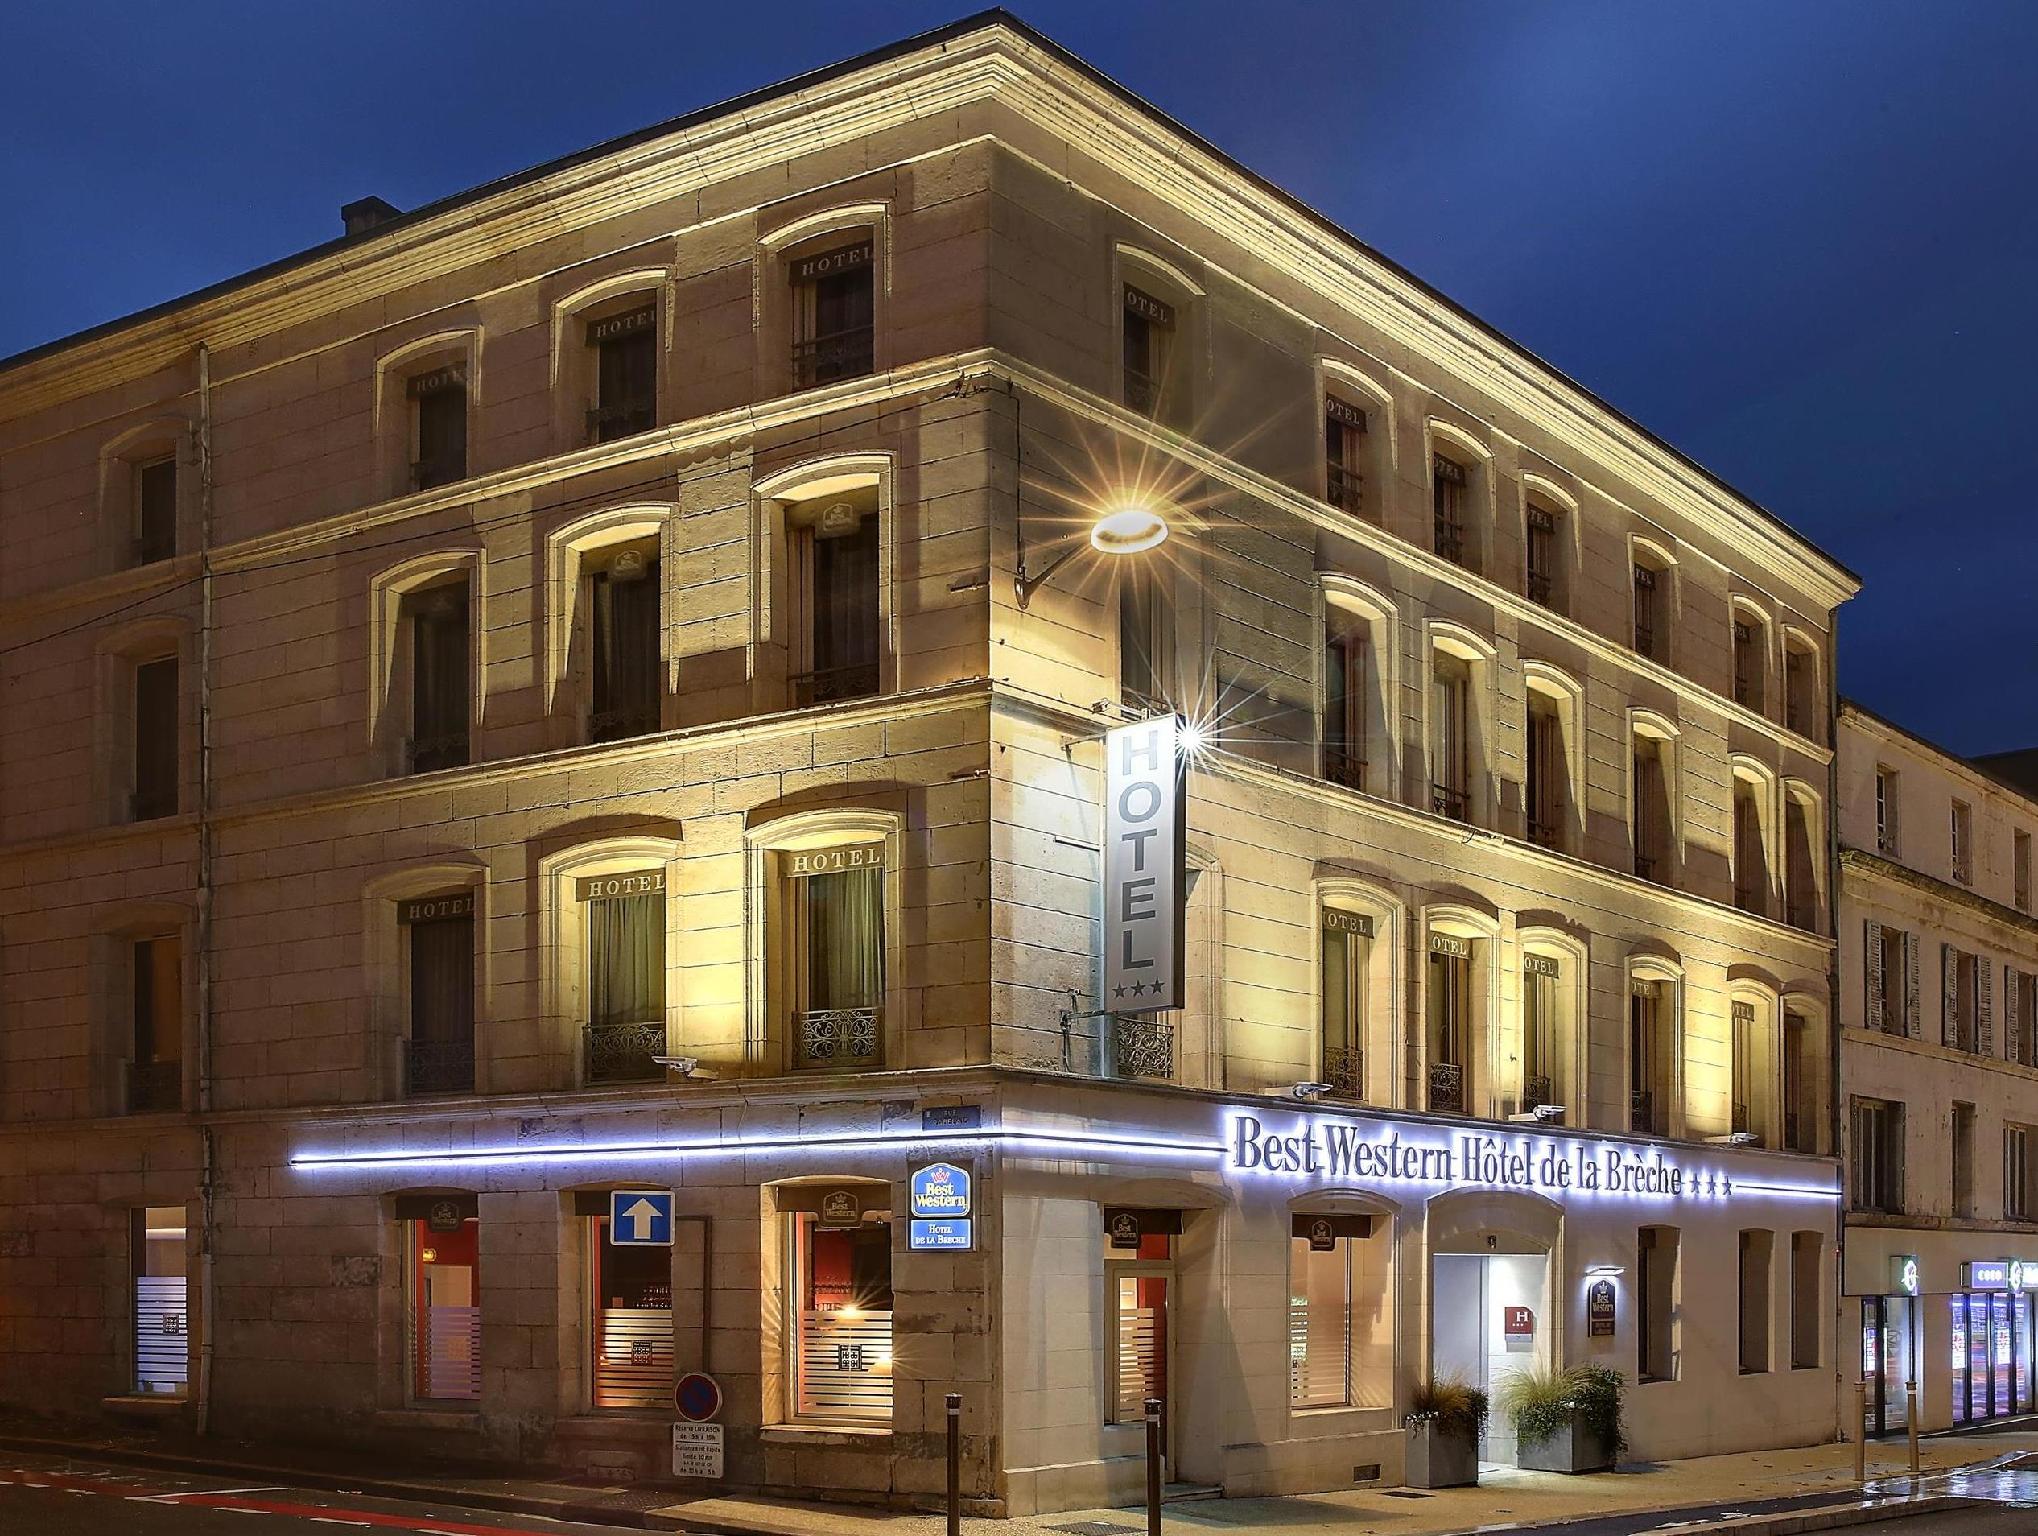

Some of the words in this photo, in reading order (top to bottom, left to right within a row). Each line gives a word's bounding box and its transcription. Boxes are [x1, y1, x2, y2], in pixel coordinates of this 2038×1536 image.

[801, 247, 872, 276] HOTEL
[1127, 291, 1168, 323] OTEL
[1326, 399, 1360, 425] OTEL
[793, 848, 881, 872] HOTEL
[1118, 730, 1162, 970] HOTEL
[588, 874, 666, 897] HOTEL
[409, 898, 472, 919] HOTEL
[1327, 913, 1367, 933] OTEL
[1432, 936, 1468, 955] OTEL
[1524, 956, 1554, 974] OTEL
[1234, 1116, 1317, 1174] Best
[1323, 1124, 1453, 1181] Western
[1461, 1136, 1535, 1185] Hôtel
[1541, 1144, 1571, 1188] de
[1576, 1146, 1600, 1190] la
[1605, 1149, 1683, 1195] Brèche
[925, 1182, 955, 1196] Best
[915, 1194, 967, 1208] Western
[1516, 1311, 1529, 1322] H
